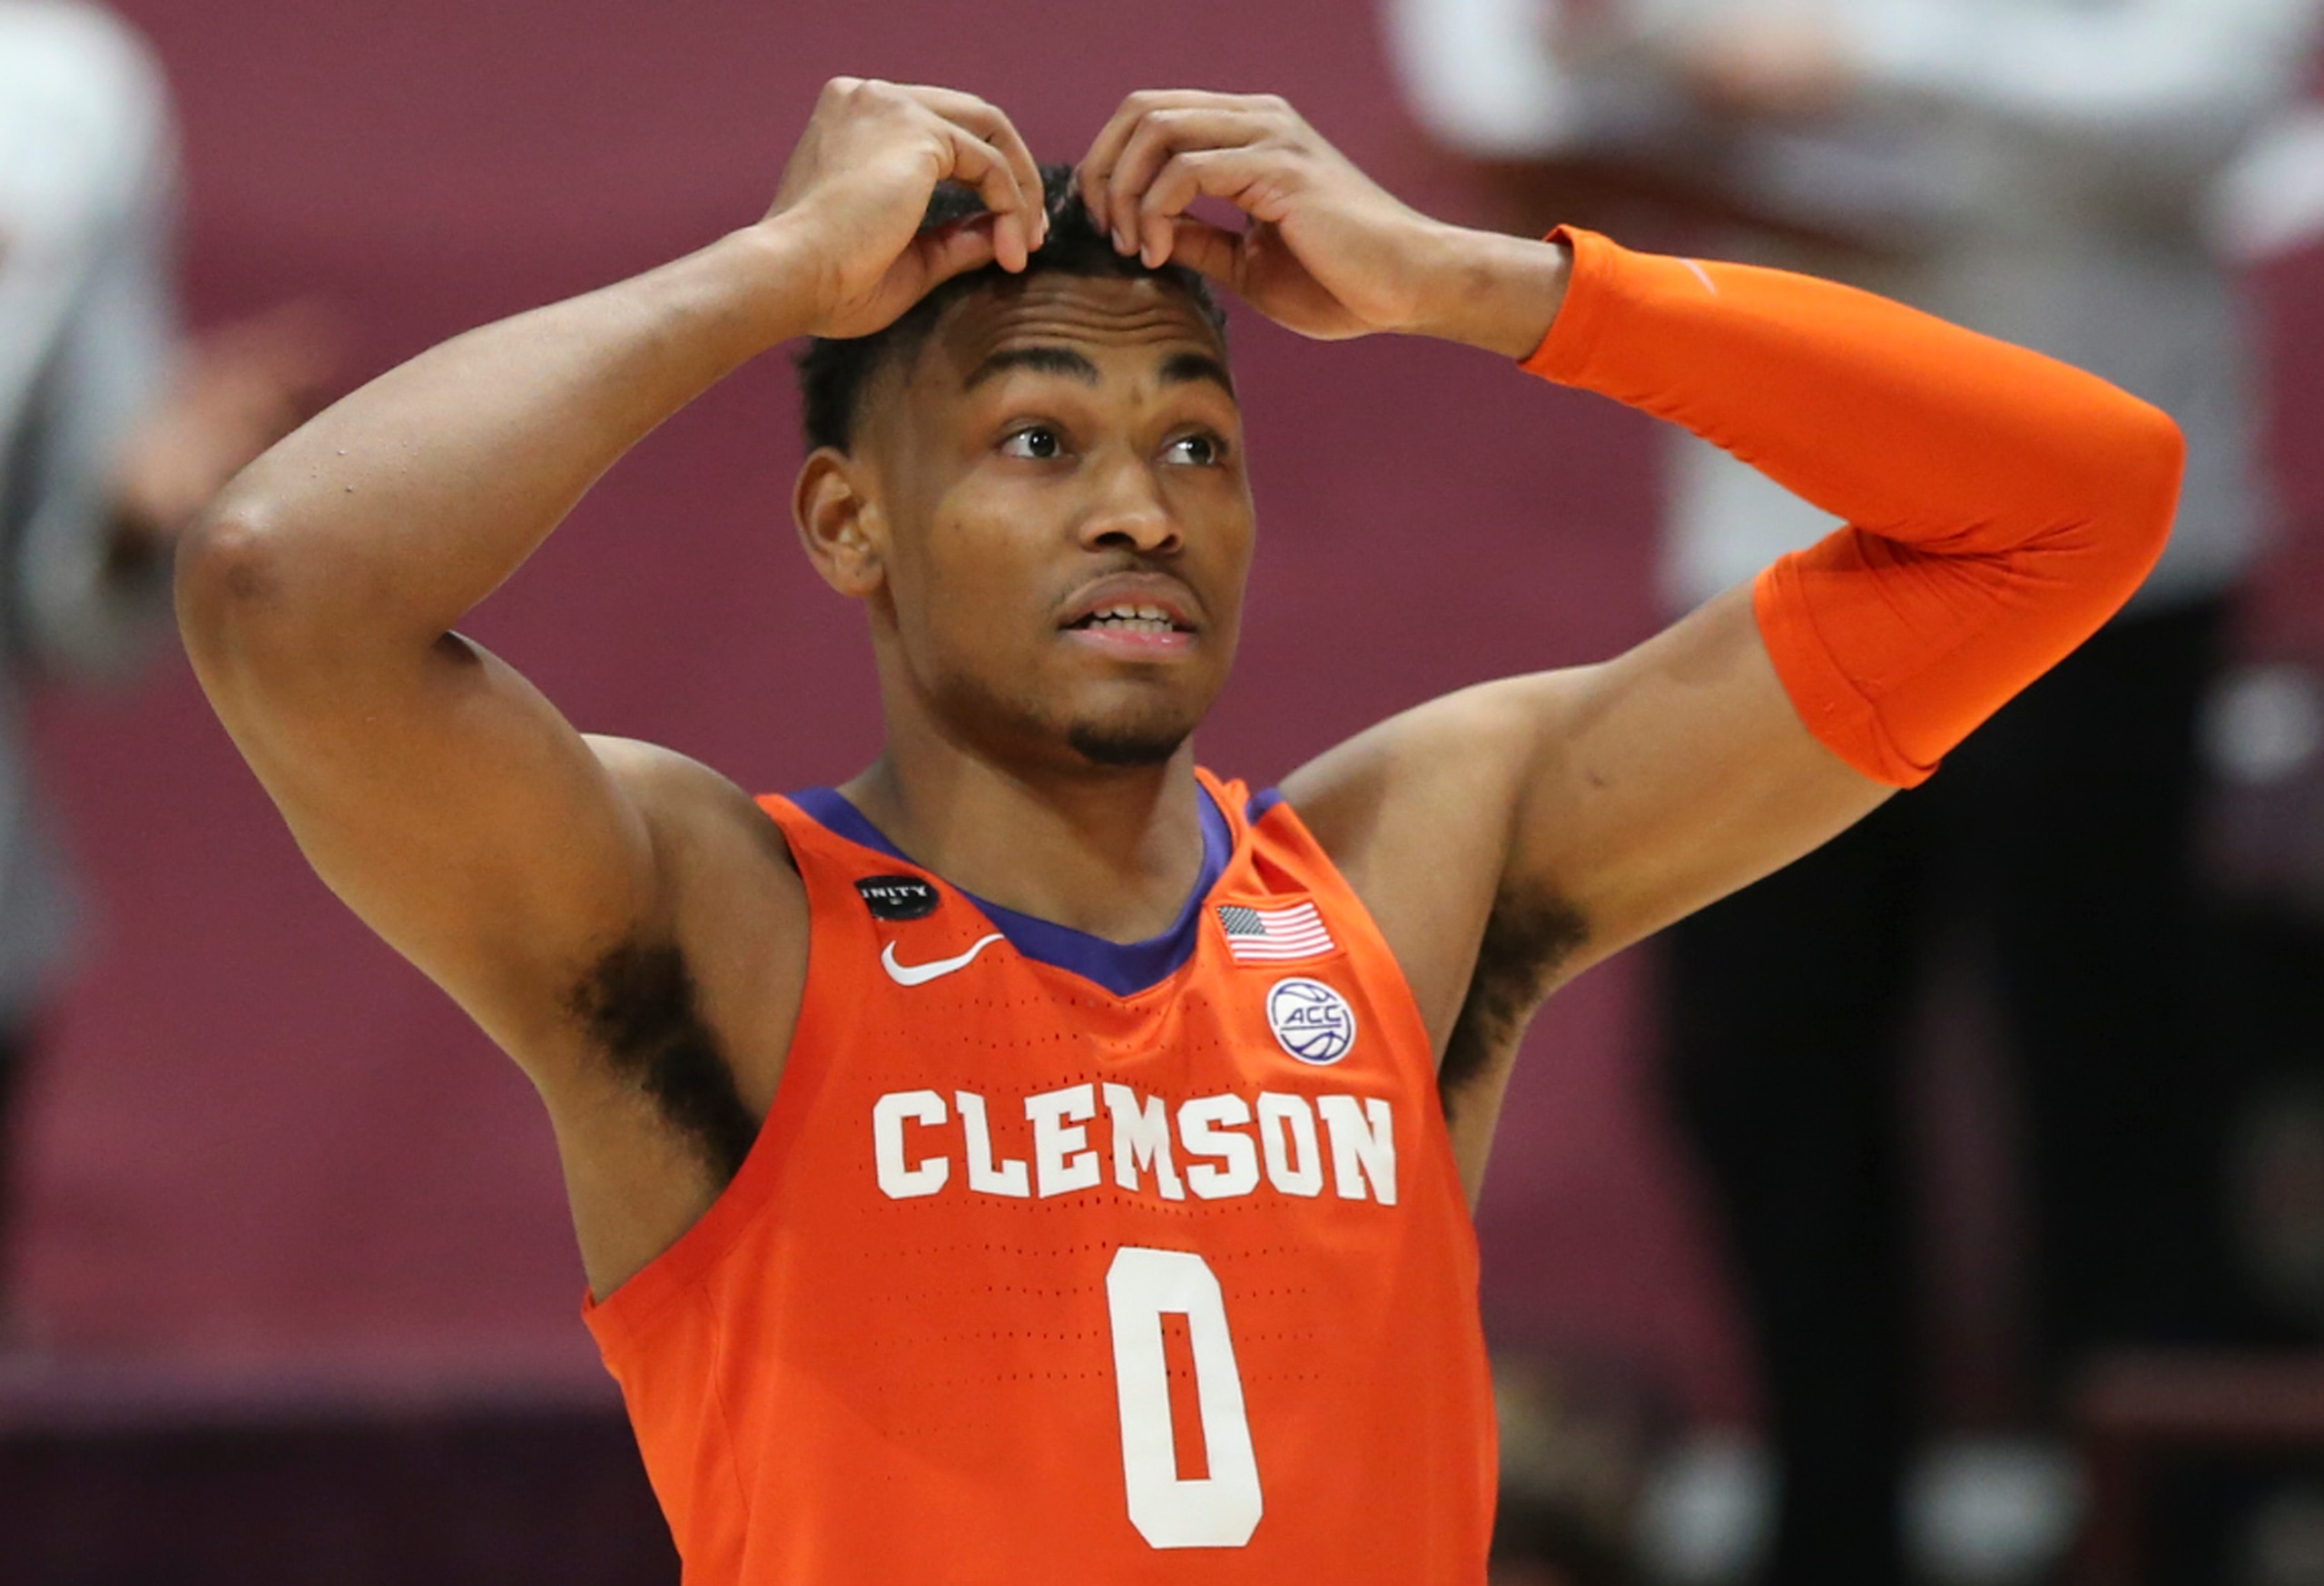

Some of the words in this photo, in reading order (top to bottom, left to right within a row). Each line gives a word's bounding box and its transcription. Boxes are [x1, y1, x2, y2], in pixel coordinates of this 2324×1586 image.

[1284, 1004, 1342, 1024] ACC
[872, 1082, 1397, 1206] CLEMSON
[1106, 1246, 1264, 1549] 0
